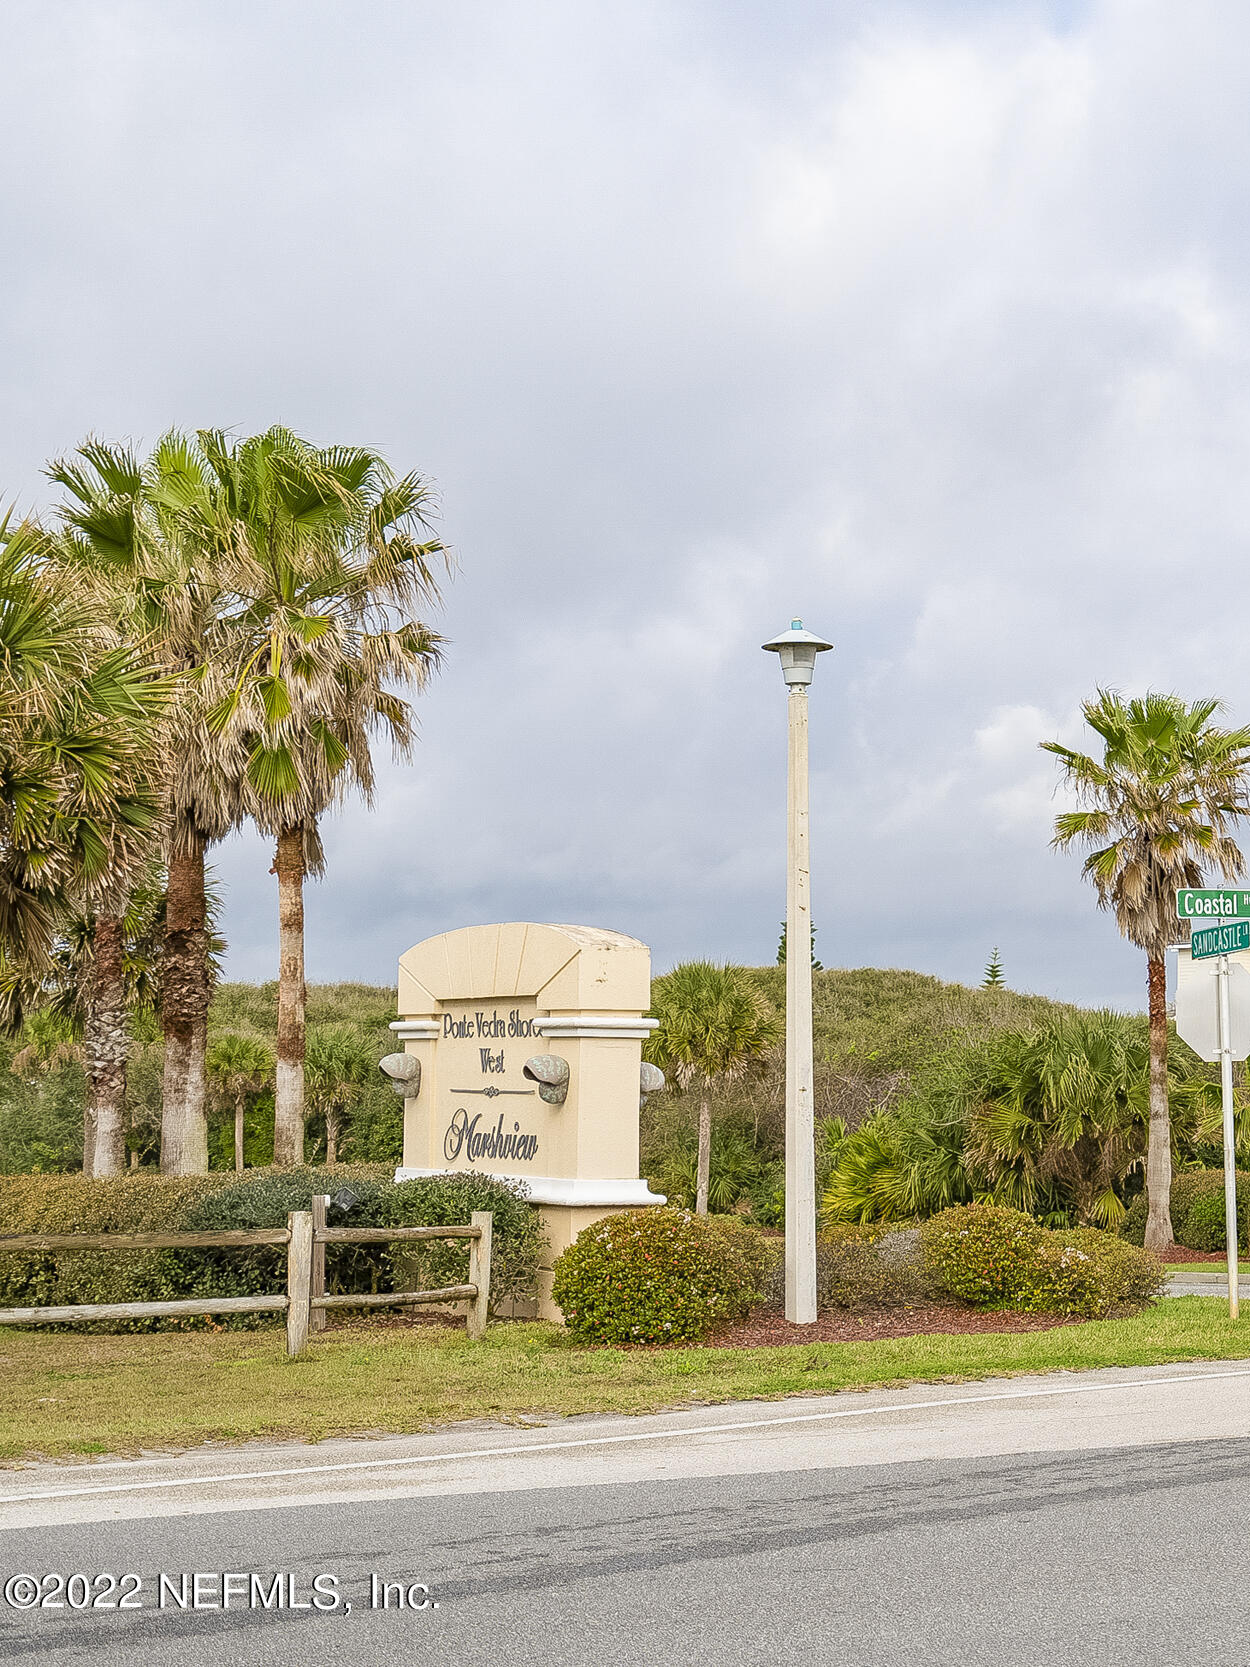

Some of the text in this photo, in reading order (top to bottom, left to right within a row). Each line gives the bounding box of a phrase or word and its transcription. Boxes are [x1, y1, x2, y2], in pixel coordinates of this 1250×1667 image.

[1184, 893, 1238, 915] Coastal
[1193, 926, 1242, 956] SANDCASTLE
[443, 1013, 475, 1039] Ponte
[475, 1010, 506, 1038] Vedra
[479, 1048, 506, 1074] West
[443, 1108, 538, 1162] Marshview
